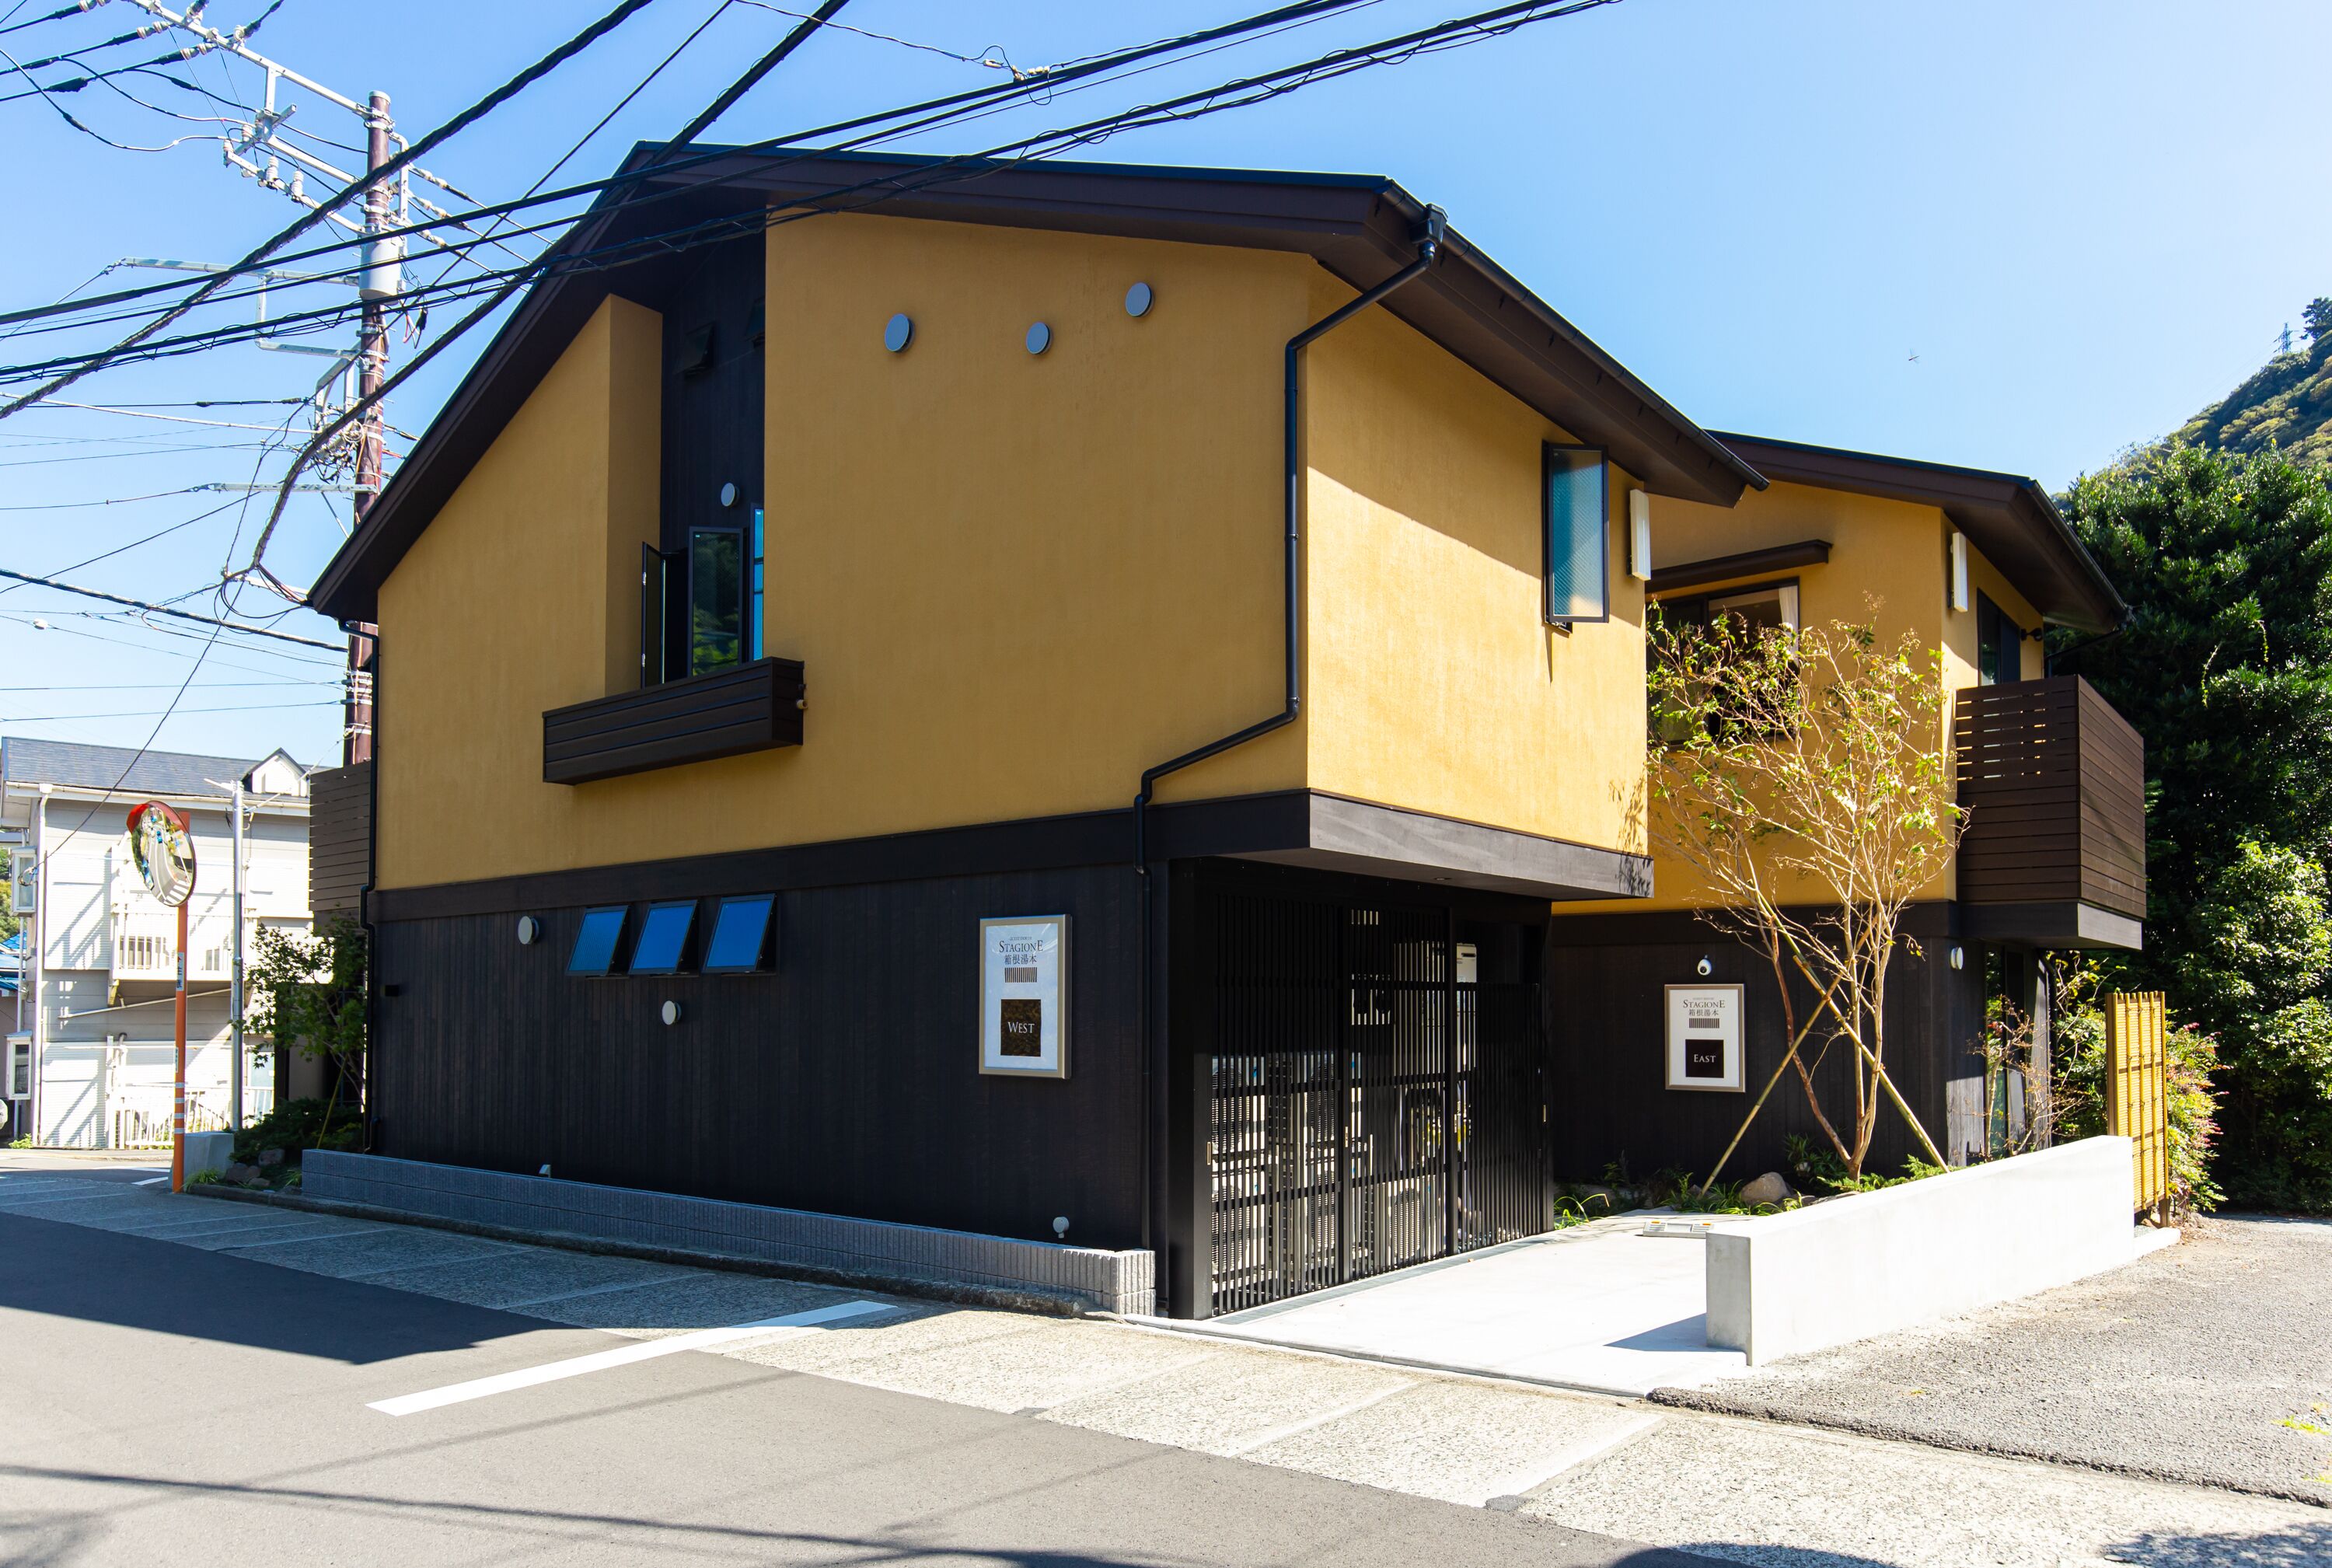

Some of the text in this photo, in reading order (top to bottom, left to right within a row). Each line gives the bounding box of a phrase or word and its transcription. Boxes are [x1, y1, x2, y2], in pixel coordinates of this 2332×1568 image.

[999, 940, 1043, 952] STAGIONE
[1004, 954, 1037, 965] 箱根湯本
[1683, 1000, 1725, 1008] STAGIONE
[1007, 1021, 1035, 1033] WEST
[1694, 1054, 1716, 1063] EAST
